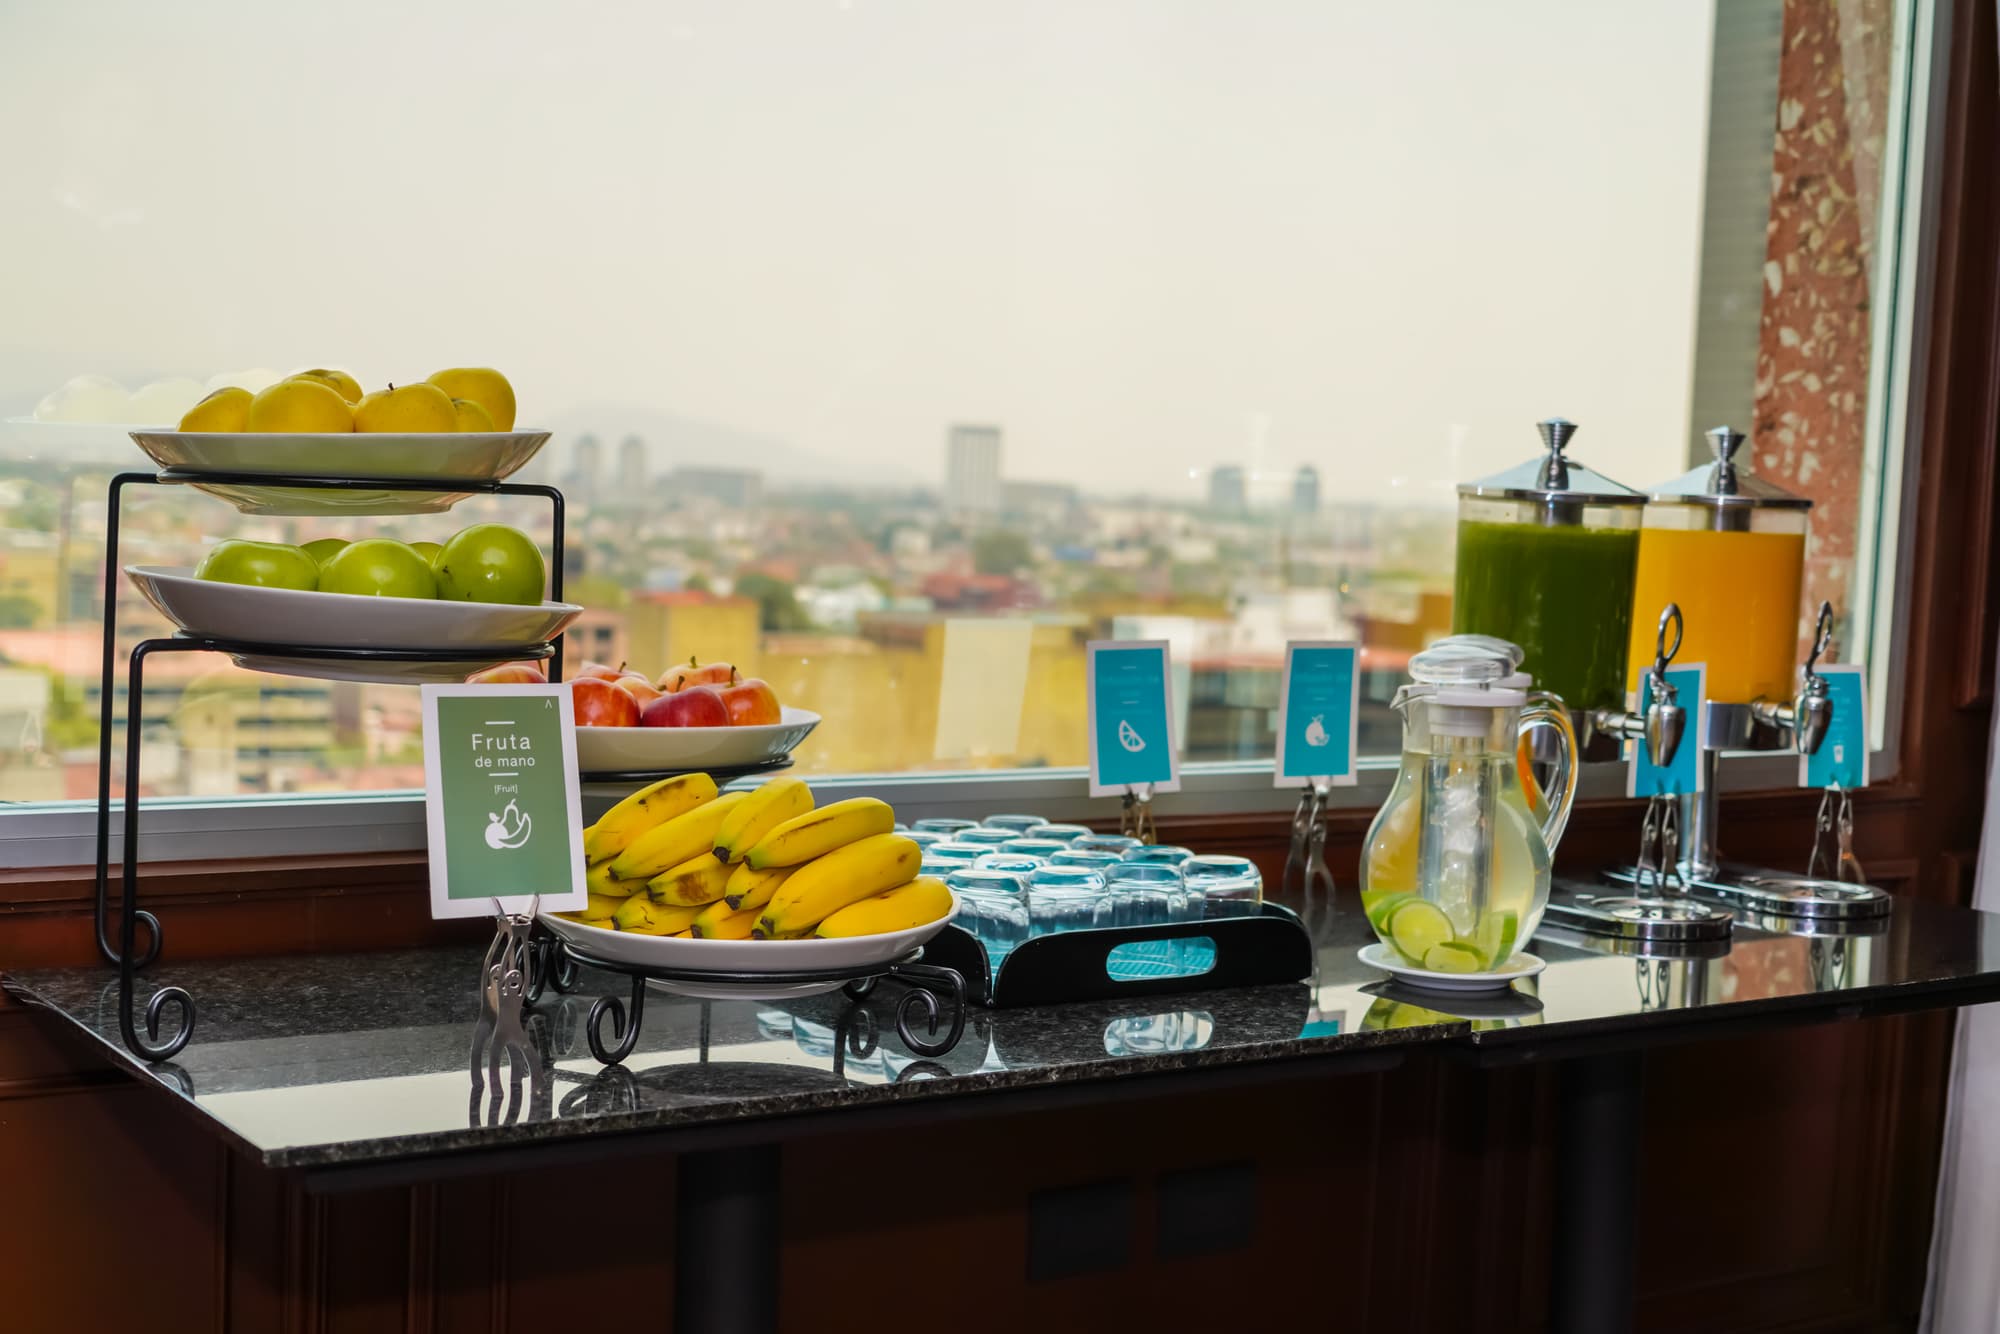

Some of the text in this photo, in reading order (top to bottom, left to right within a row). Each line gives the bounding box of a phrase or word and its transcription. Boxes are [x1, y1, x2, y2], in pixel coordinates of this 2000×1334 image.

[471, 733, 531, 751] Fruta
[474, 755, 536, 768] de mano
